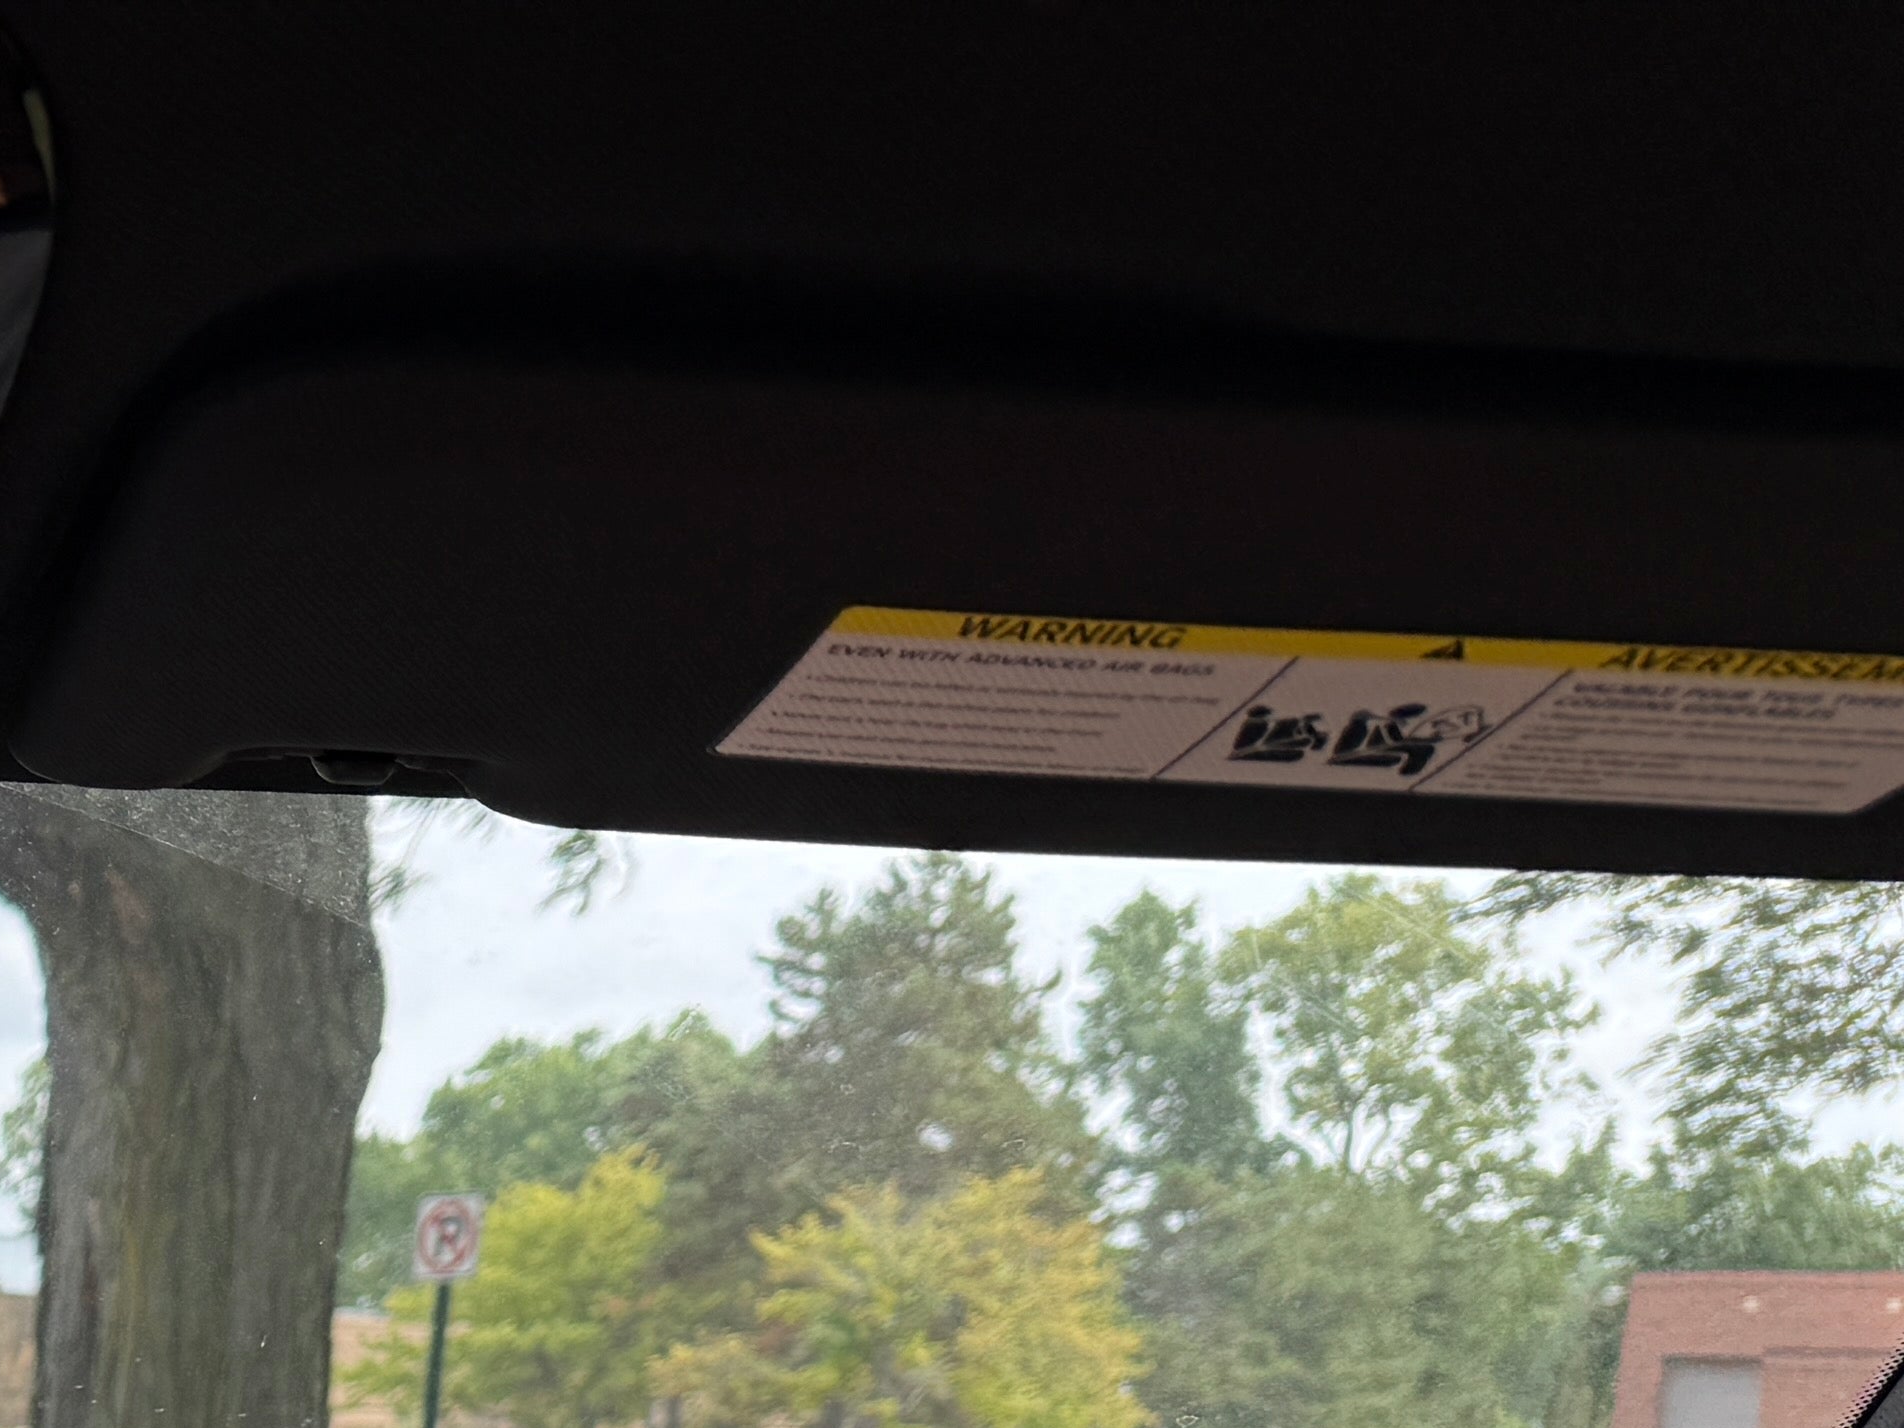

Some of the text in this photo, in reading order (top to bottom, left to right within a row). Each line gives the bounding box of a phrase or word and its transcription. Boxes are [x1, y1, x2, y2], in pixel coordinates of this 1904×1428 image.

[957, 616, 1187, 649] WARNING
[826, 643, 891, 660] EVEN
[897, 647, 960, 665] WITH
[967, 652, 1097, 672] ADVANCED
[1103, 659, 1145, 676] AIR
